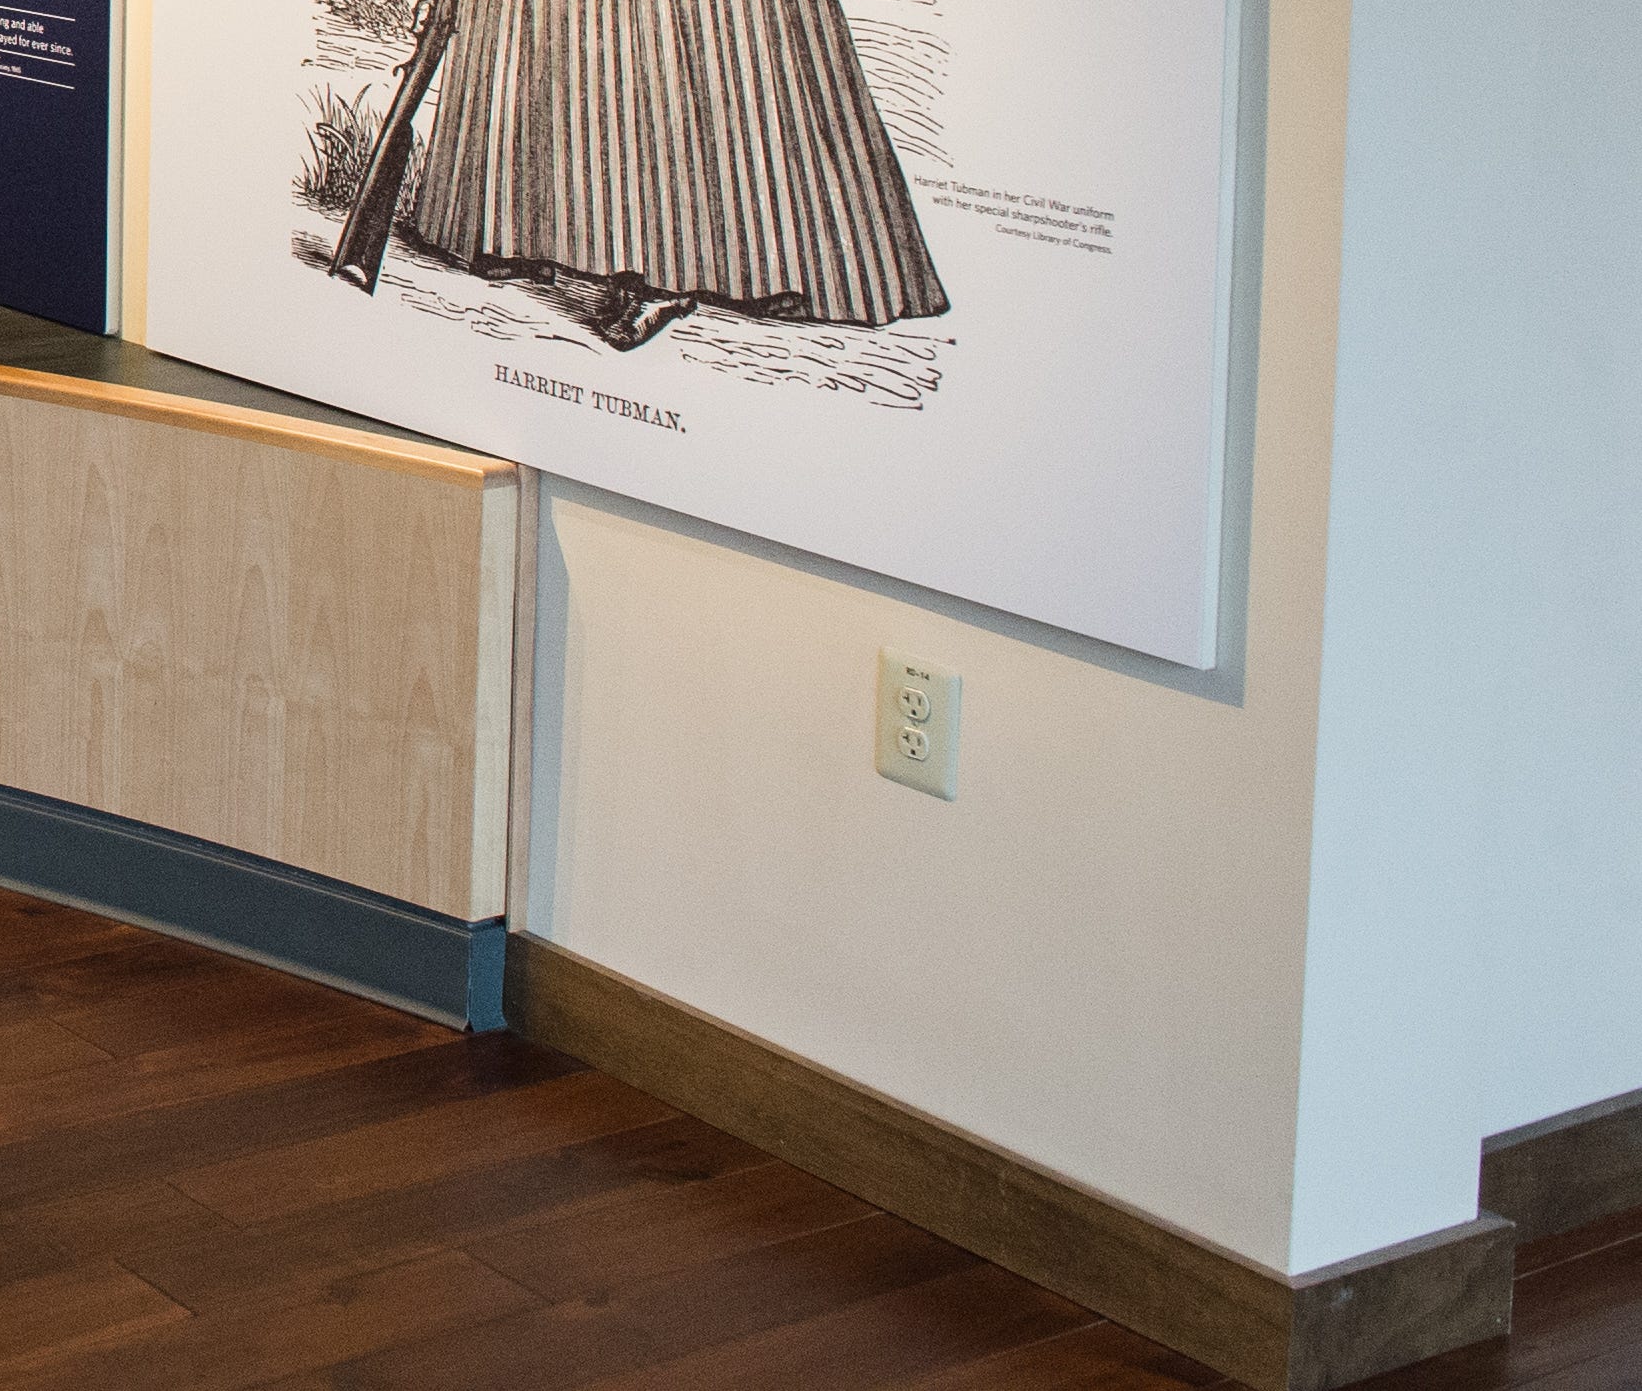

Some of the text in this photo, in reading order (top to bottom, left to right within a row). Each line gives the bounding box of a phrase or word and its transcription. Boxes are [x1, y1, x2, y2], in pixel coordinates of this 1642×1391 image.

[11, 20, 25, 30] and
[27, 22, 44, 34] able
[18, 35, 29, 46] for
[31, 41, 48, 50] ever
[50, 43, 73, 55] since.
[914, 175, 1114, 220] Harriet Tubman in her Civil War uniform
[933, 196, 953, 206] with
[956, 199, 971, 210] her
[975, 205, 1008, 217] special
[1090, 225, 1113, 237] rifle.
[996, 224, 1031, 240] Courtesy
[1032, 232, 1061, 245] Library
[1073, 239, 1112, 254] Congress.
[495, 364, 686, 433] HARRIET TUBMAN.
